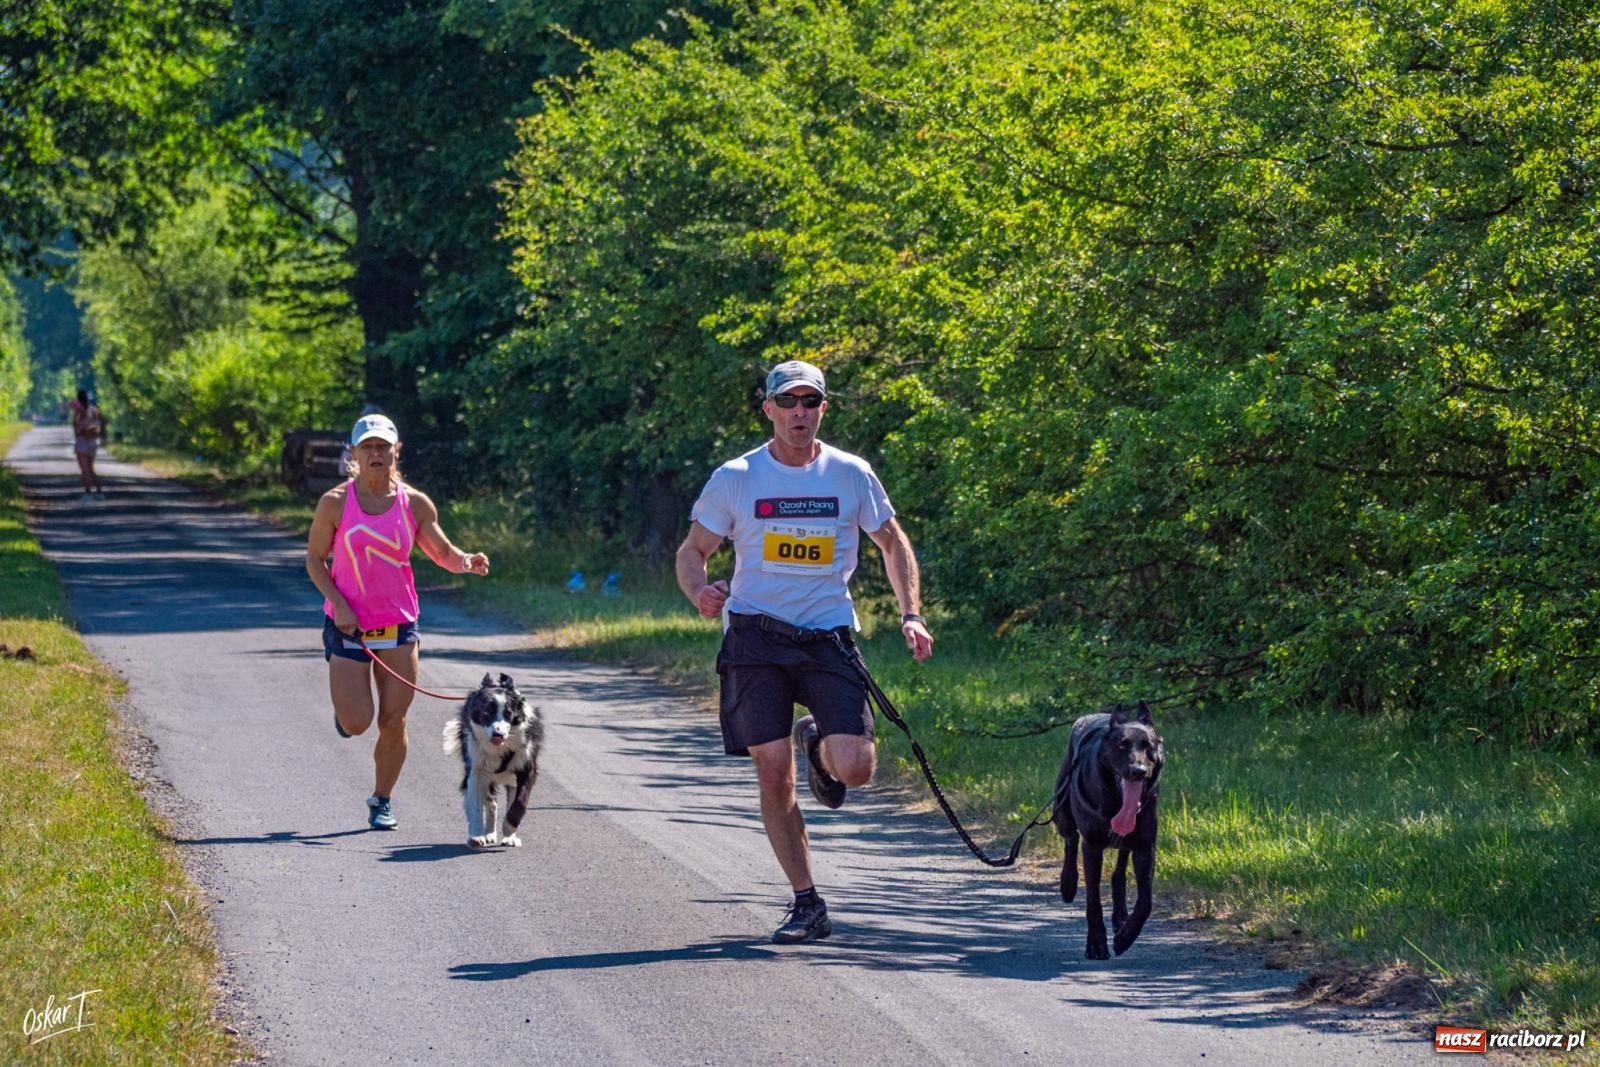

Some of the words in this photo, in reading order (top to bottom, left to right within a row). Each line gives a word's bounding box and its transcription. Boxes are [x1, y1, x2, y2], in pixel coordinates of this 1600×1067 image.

[808, 501, 834, 510] Racing
[778, 542, 821, 561] 006
[360, 627, 386, 637] 29
